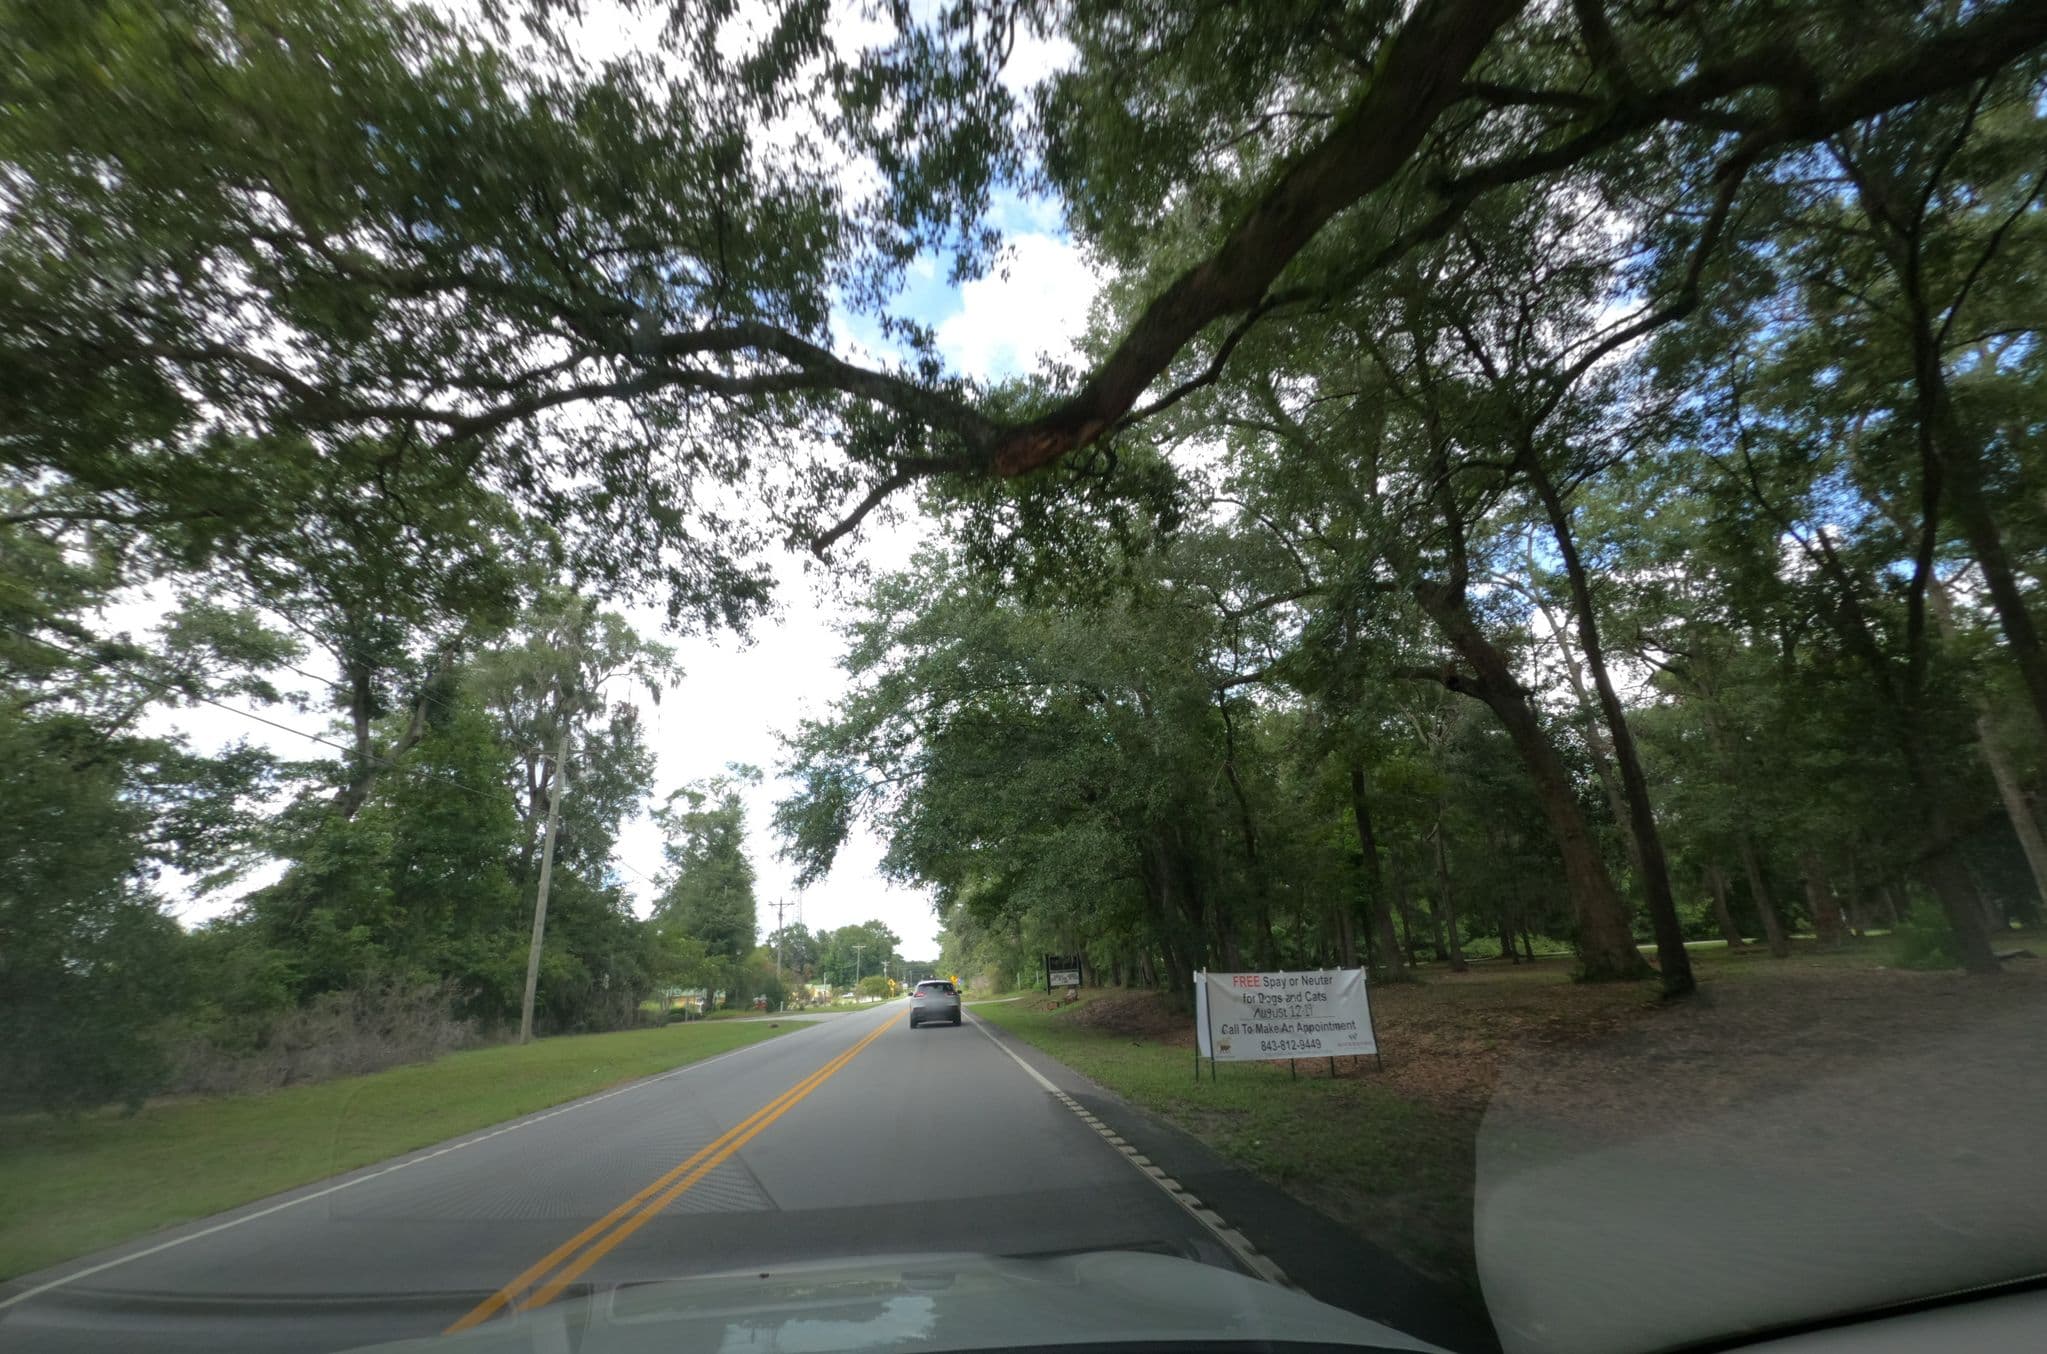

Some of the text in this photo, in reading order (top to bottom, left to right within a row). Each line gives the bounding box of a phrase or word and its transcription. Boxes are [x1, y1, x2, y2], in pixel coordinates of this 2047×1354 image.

[1232, 975, 1332, 989] FREE Spay or Neuter
[1243, 991, 1327, 1006] for Dogs and Cats
[1253, 1007, 1288, 1019] August
[1222, 1020, 1357, 1035] Call To Make An Appointment
